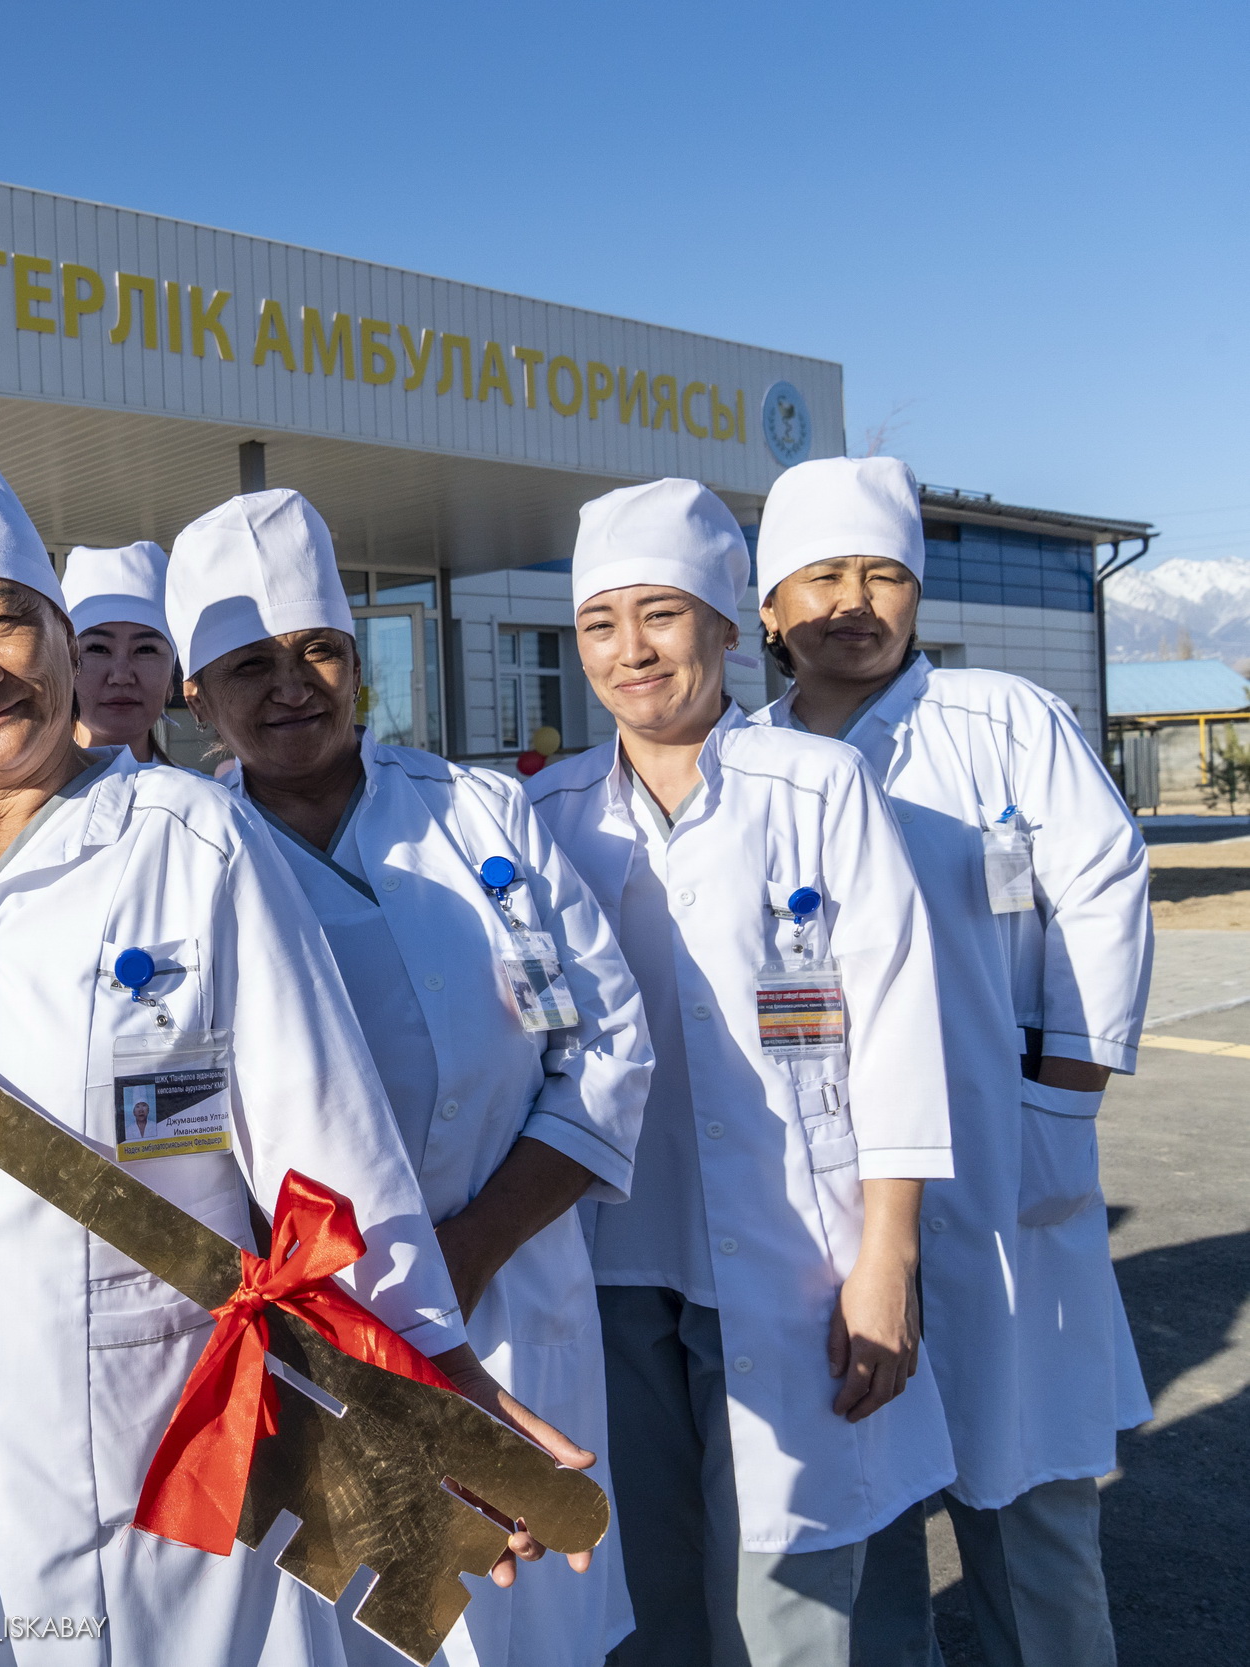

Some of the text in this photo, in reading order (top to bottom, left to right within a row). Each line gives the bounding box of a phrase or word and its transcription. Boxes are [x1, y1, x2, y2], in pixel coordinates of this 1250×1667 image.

[253, 297, 746, 444] АМБУЛАТОРИЯСЫ
[166, 1112, 229, 1127] Джумашева Ултай
[173, 1125, 223, 1136] Иманжановна
